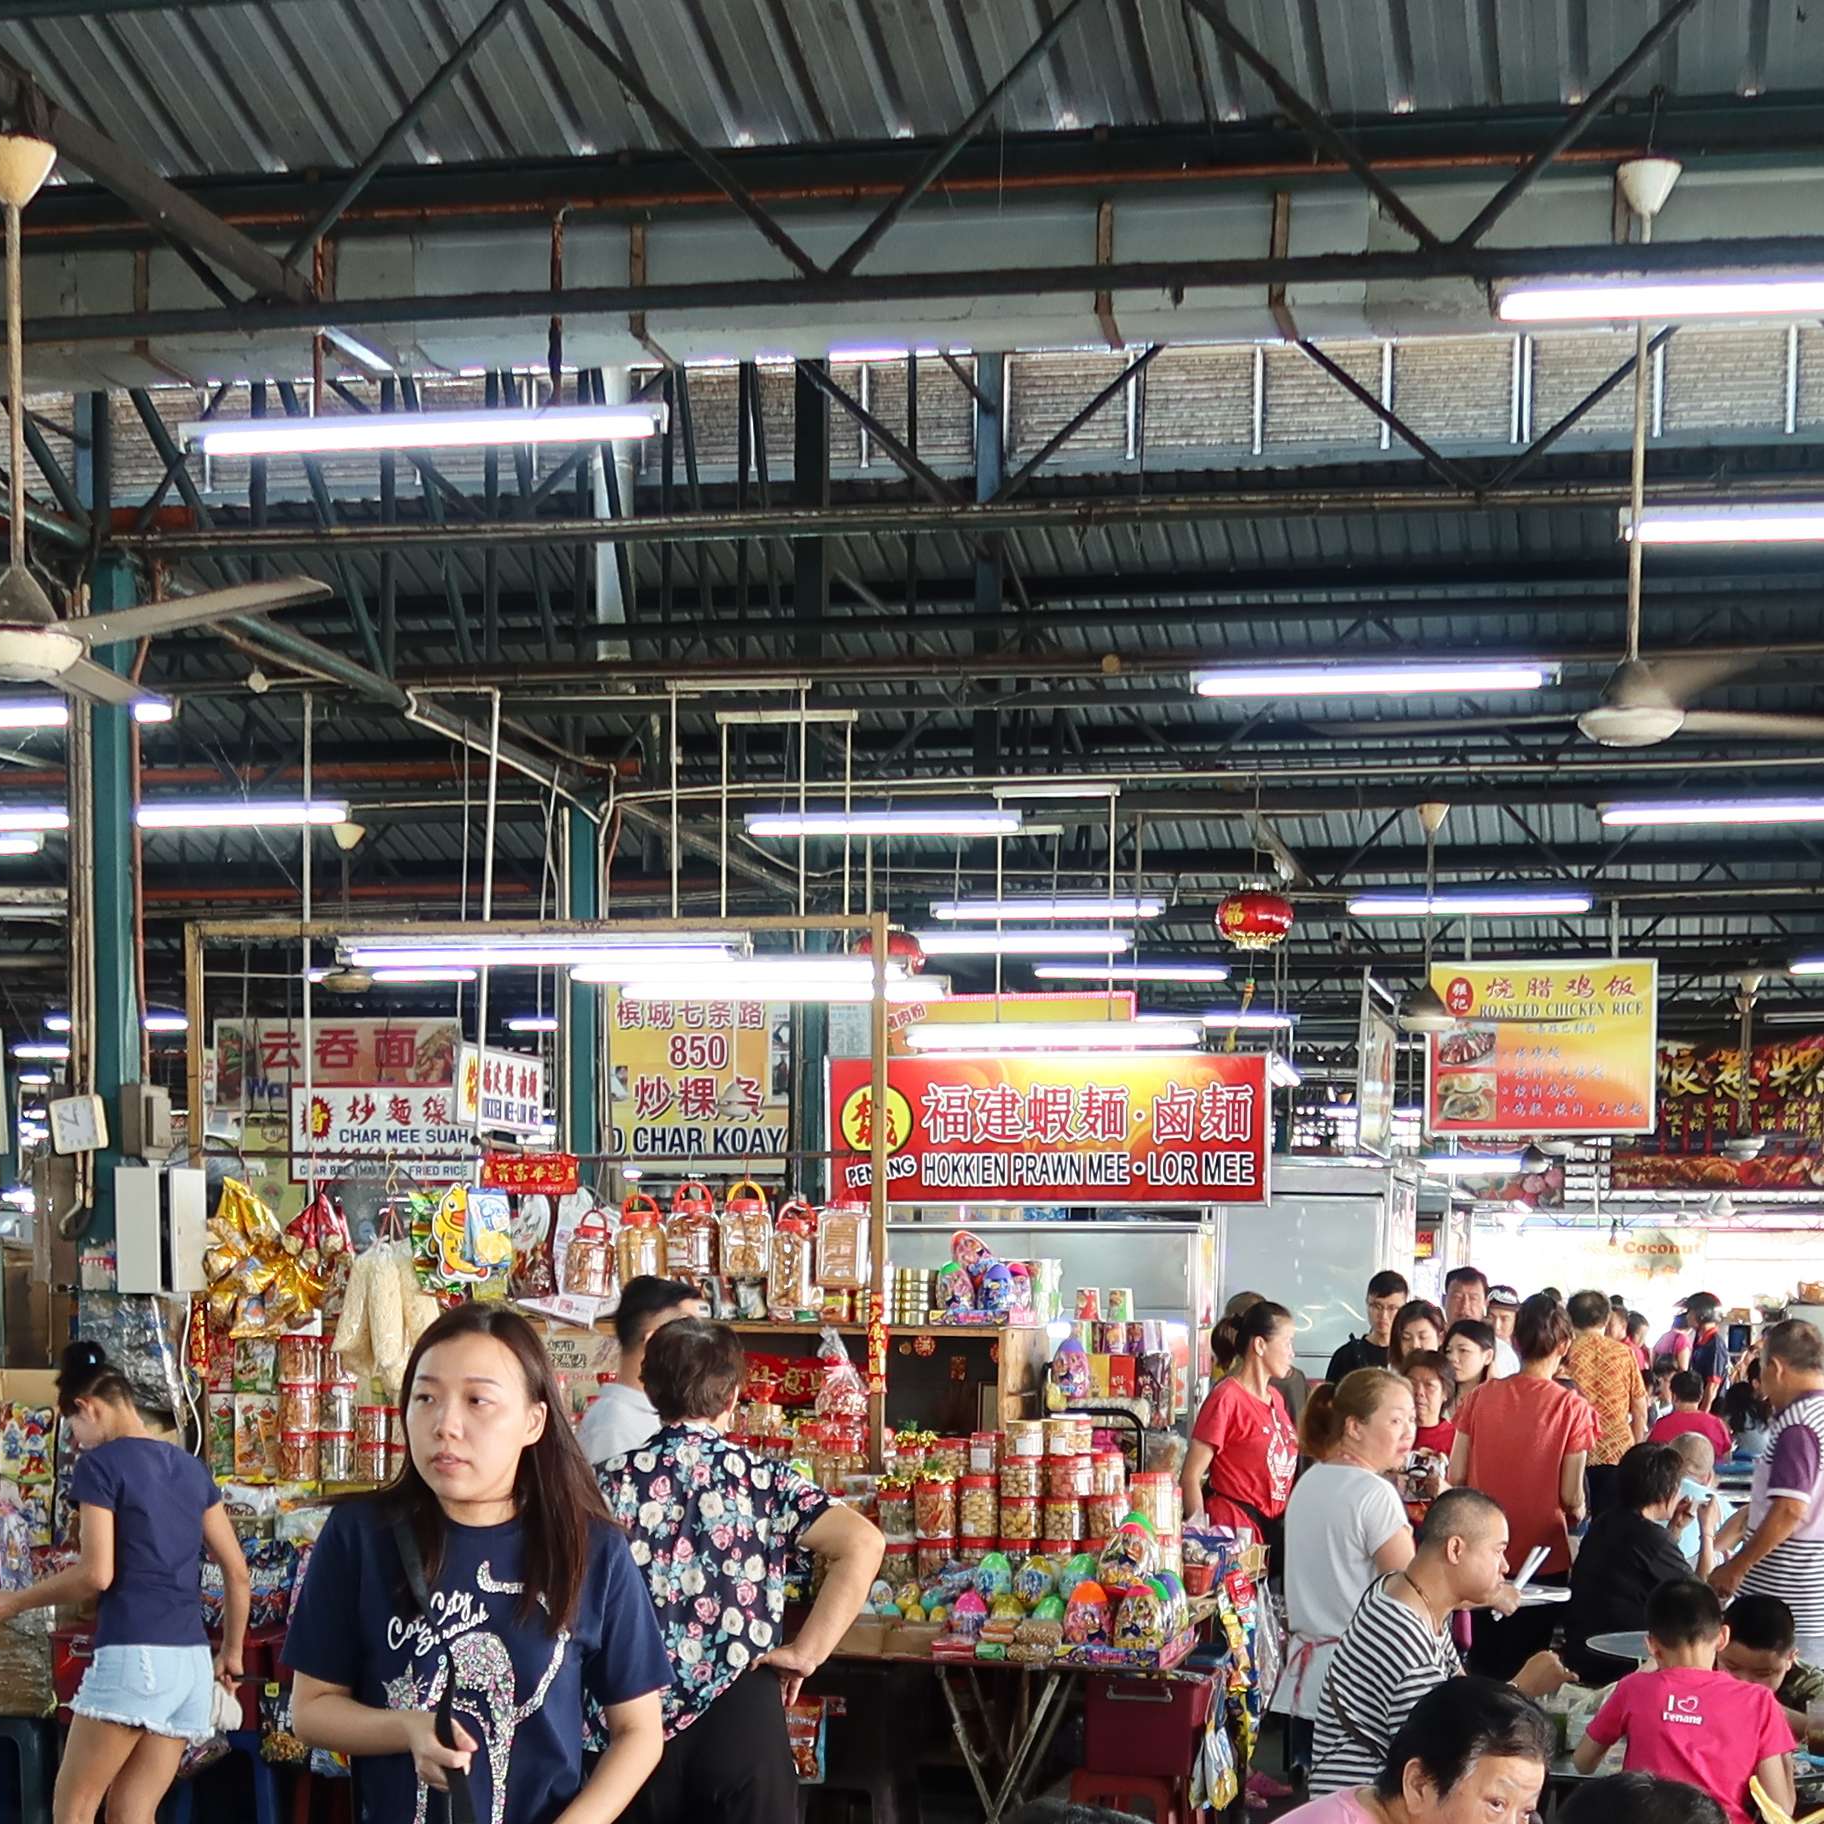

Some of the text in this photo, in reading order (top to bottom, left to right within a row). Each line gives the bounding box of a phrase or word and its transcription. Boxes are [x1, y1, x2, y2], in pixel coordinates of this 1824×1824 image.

[616, 1000, 764, 1027] 槟城七条路
[1479, 1000, 1644, 1018] ROASTED CHICKEN RICE
[259, 1029, 418, 1070] 云吞面
[670, 1035, 727, 1067] 850
[339, 1129, 469, 1145] CHAR MEE SUAH
[633, 1127, 784, 1154] CHAR KOAY
[408, 1164, 440, 1177] FRIED
[442, 1164, 468, 1177] RICE
[847, 1152, 1254, 1187] PENNG HOKKIEN PRAWN MEE LOR MEE
[1623, 1241, 1702, 1255] Coconut
[387, 1589, 474, 1651] Cat City
[1667, 1694, 1675, 1712] I
[1662, 1711, 1703, 1726] Penang
